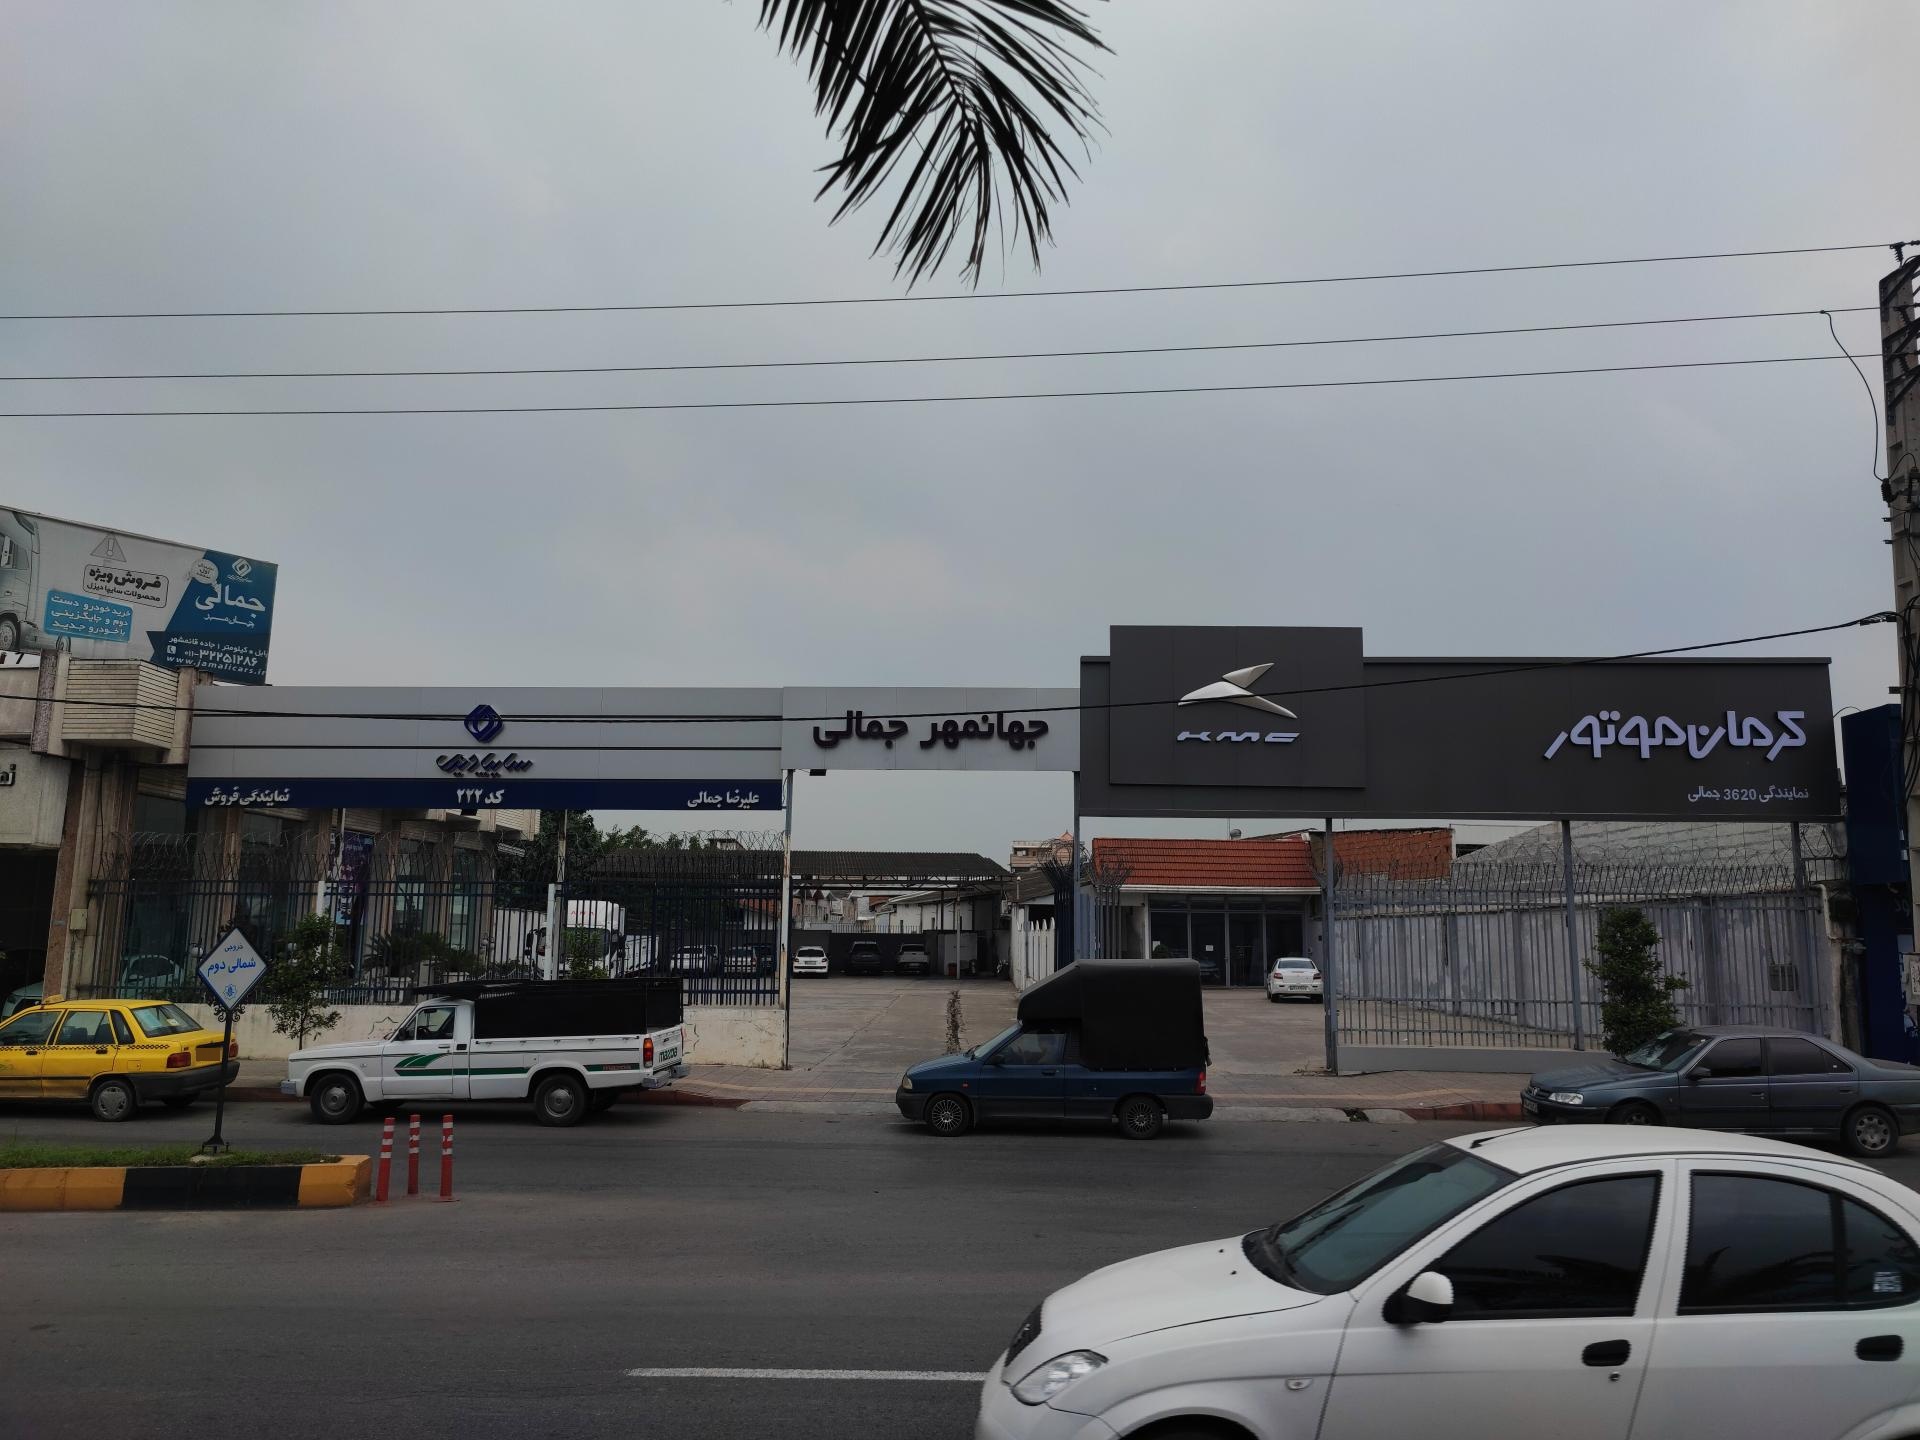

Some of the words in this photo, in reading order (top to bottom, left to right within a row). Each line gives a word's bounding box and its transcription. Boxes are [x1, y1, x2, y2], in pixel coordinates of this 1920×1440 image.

[89, 568, 114, 584] ویژه
[114, 572, 161, 591] فروش
[50, 595, 79, 607] دست
[124, 589, 161, 602] محصولات
[195, 583, 266, 619] جمالی
[83, 603, 111, 613] خودرو
[52, 619, 86, 631] جدید
[812, 709, 910, 750] جمالی
[919, 711, 1049, 751] جهانمهر
[1176, 731, 1301, 743] KMC
[1543, 710, 1688, 760] موتور
[1687, 710, 1807, 763] کرمان
[204, 785, 240, 806] فروش
[239, 787, 291, 806] نمایندگی
[456, 788, 483, 804] ۲۲۲
[484, 788, 505, 804] کد
[687, 790, 723, 808] جمالی
[725, 788, 760, 810] علیرضا
[1686, 785, 1721, 802] جمالی
[1723, 788, 1757, 801] 3620
[1758, 784, 1810, 803] نمایندگی
[207, 960, 226, 977] دوم
[228, 957, 256, 974] شمالی
